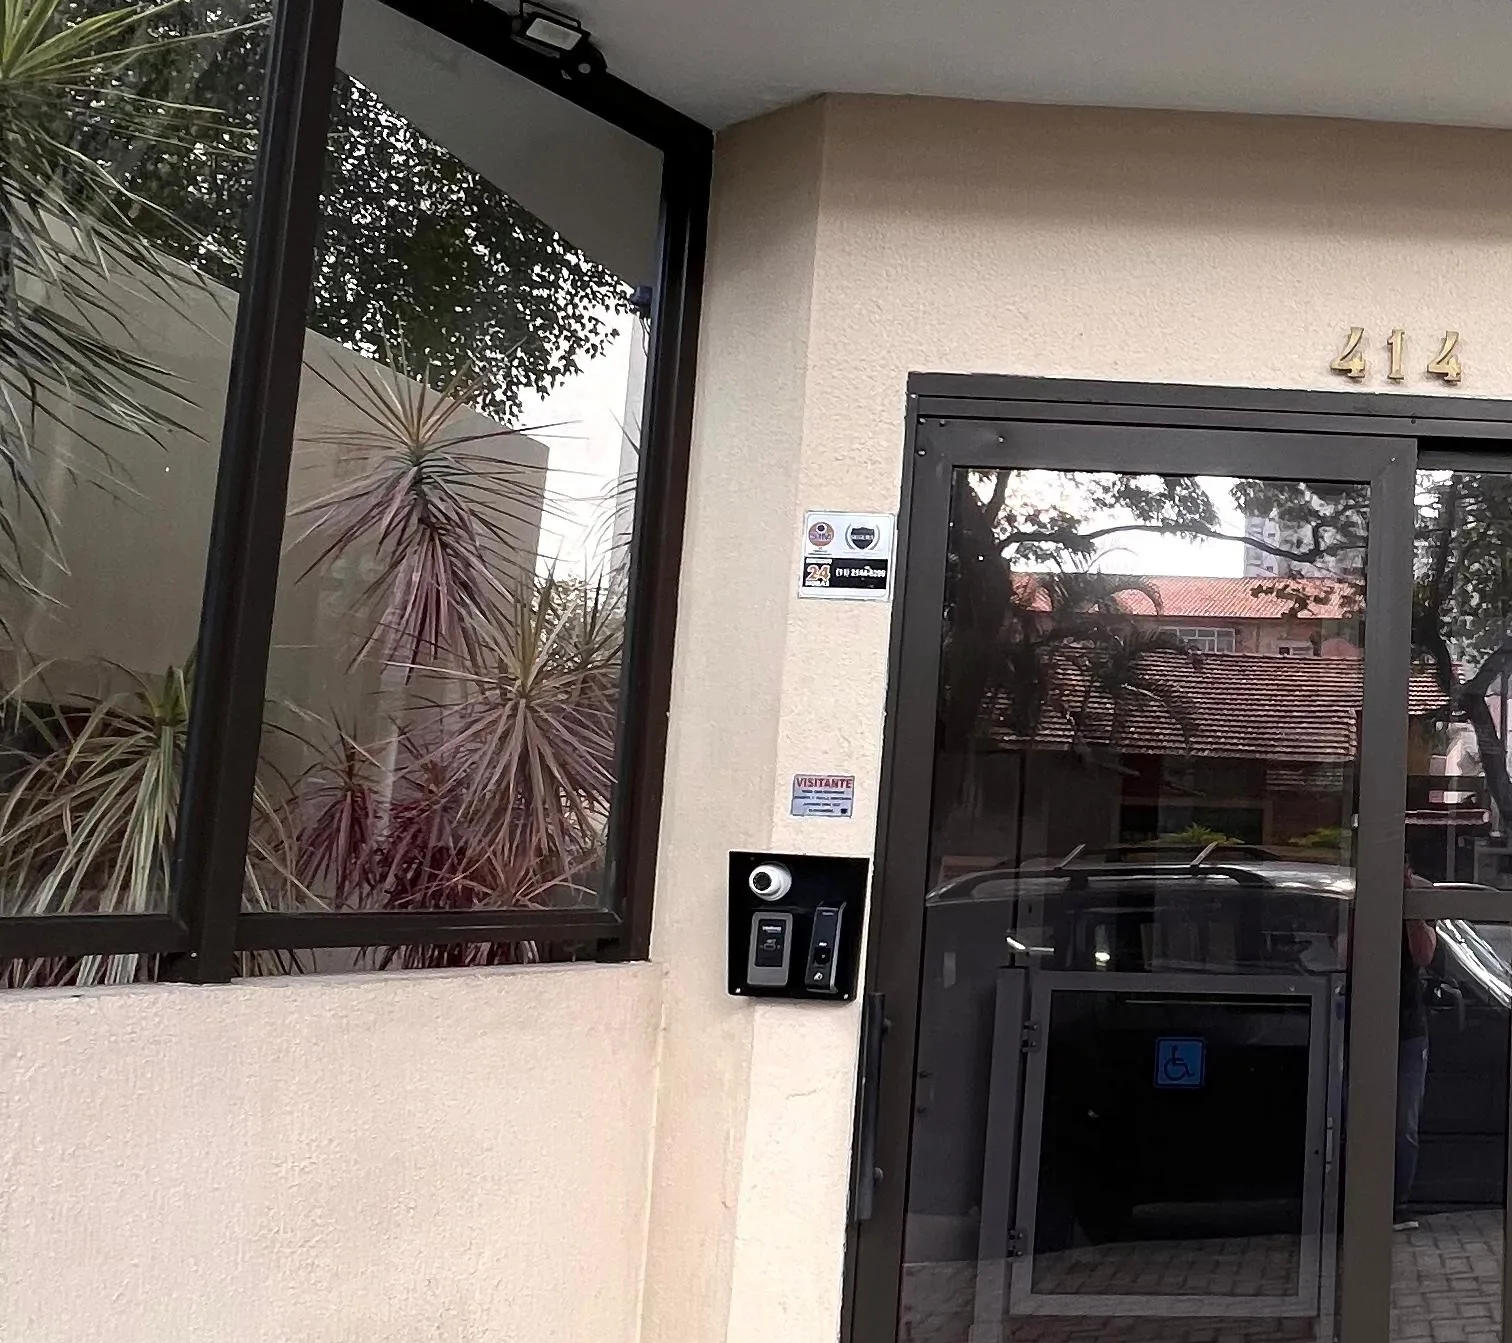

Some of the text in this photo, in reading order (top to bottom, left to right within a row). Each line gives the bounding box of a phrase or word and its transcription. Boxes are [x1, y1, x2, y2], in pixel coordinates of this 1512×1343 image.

[1330, 326, 1462, 383] 414
[806, 564, 831, 582] 24
[796, 777, 853, 789] VISITANTE
